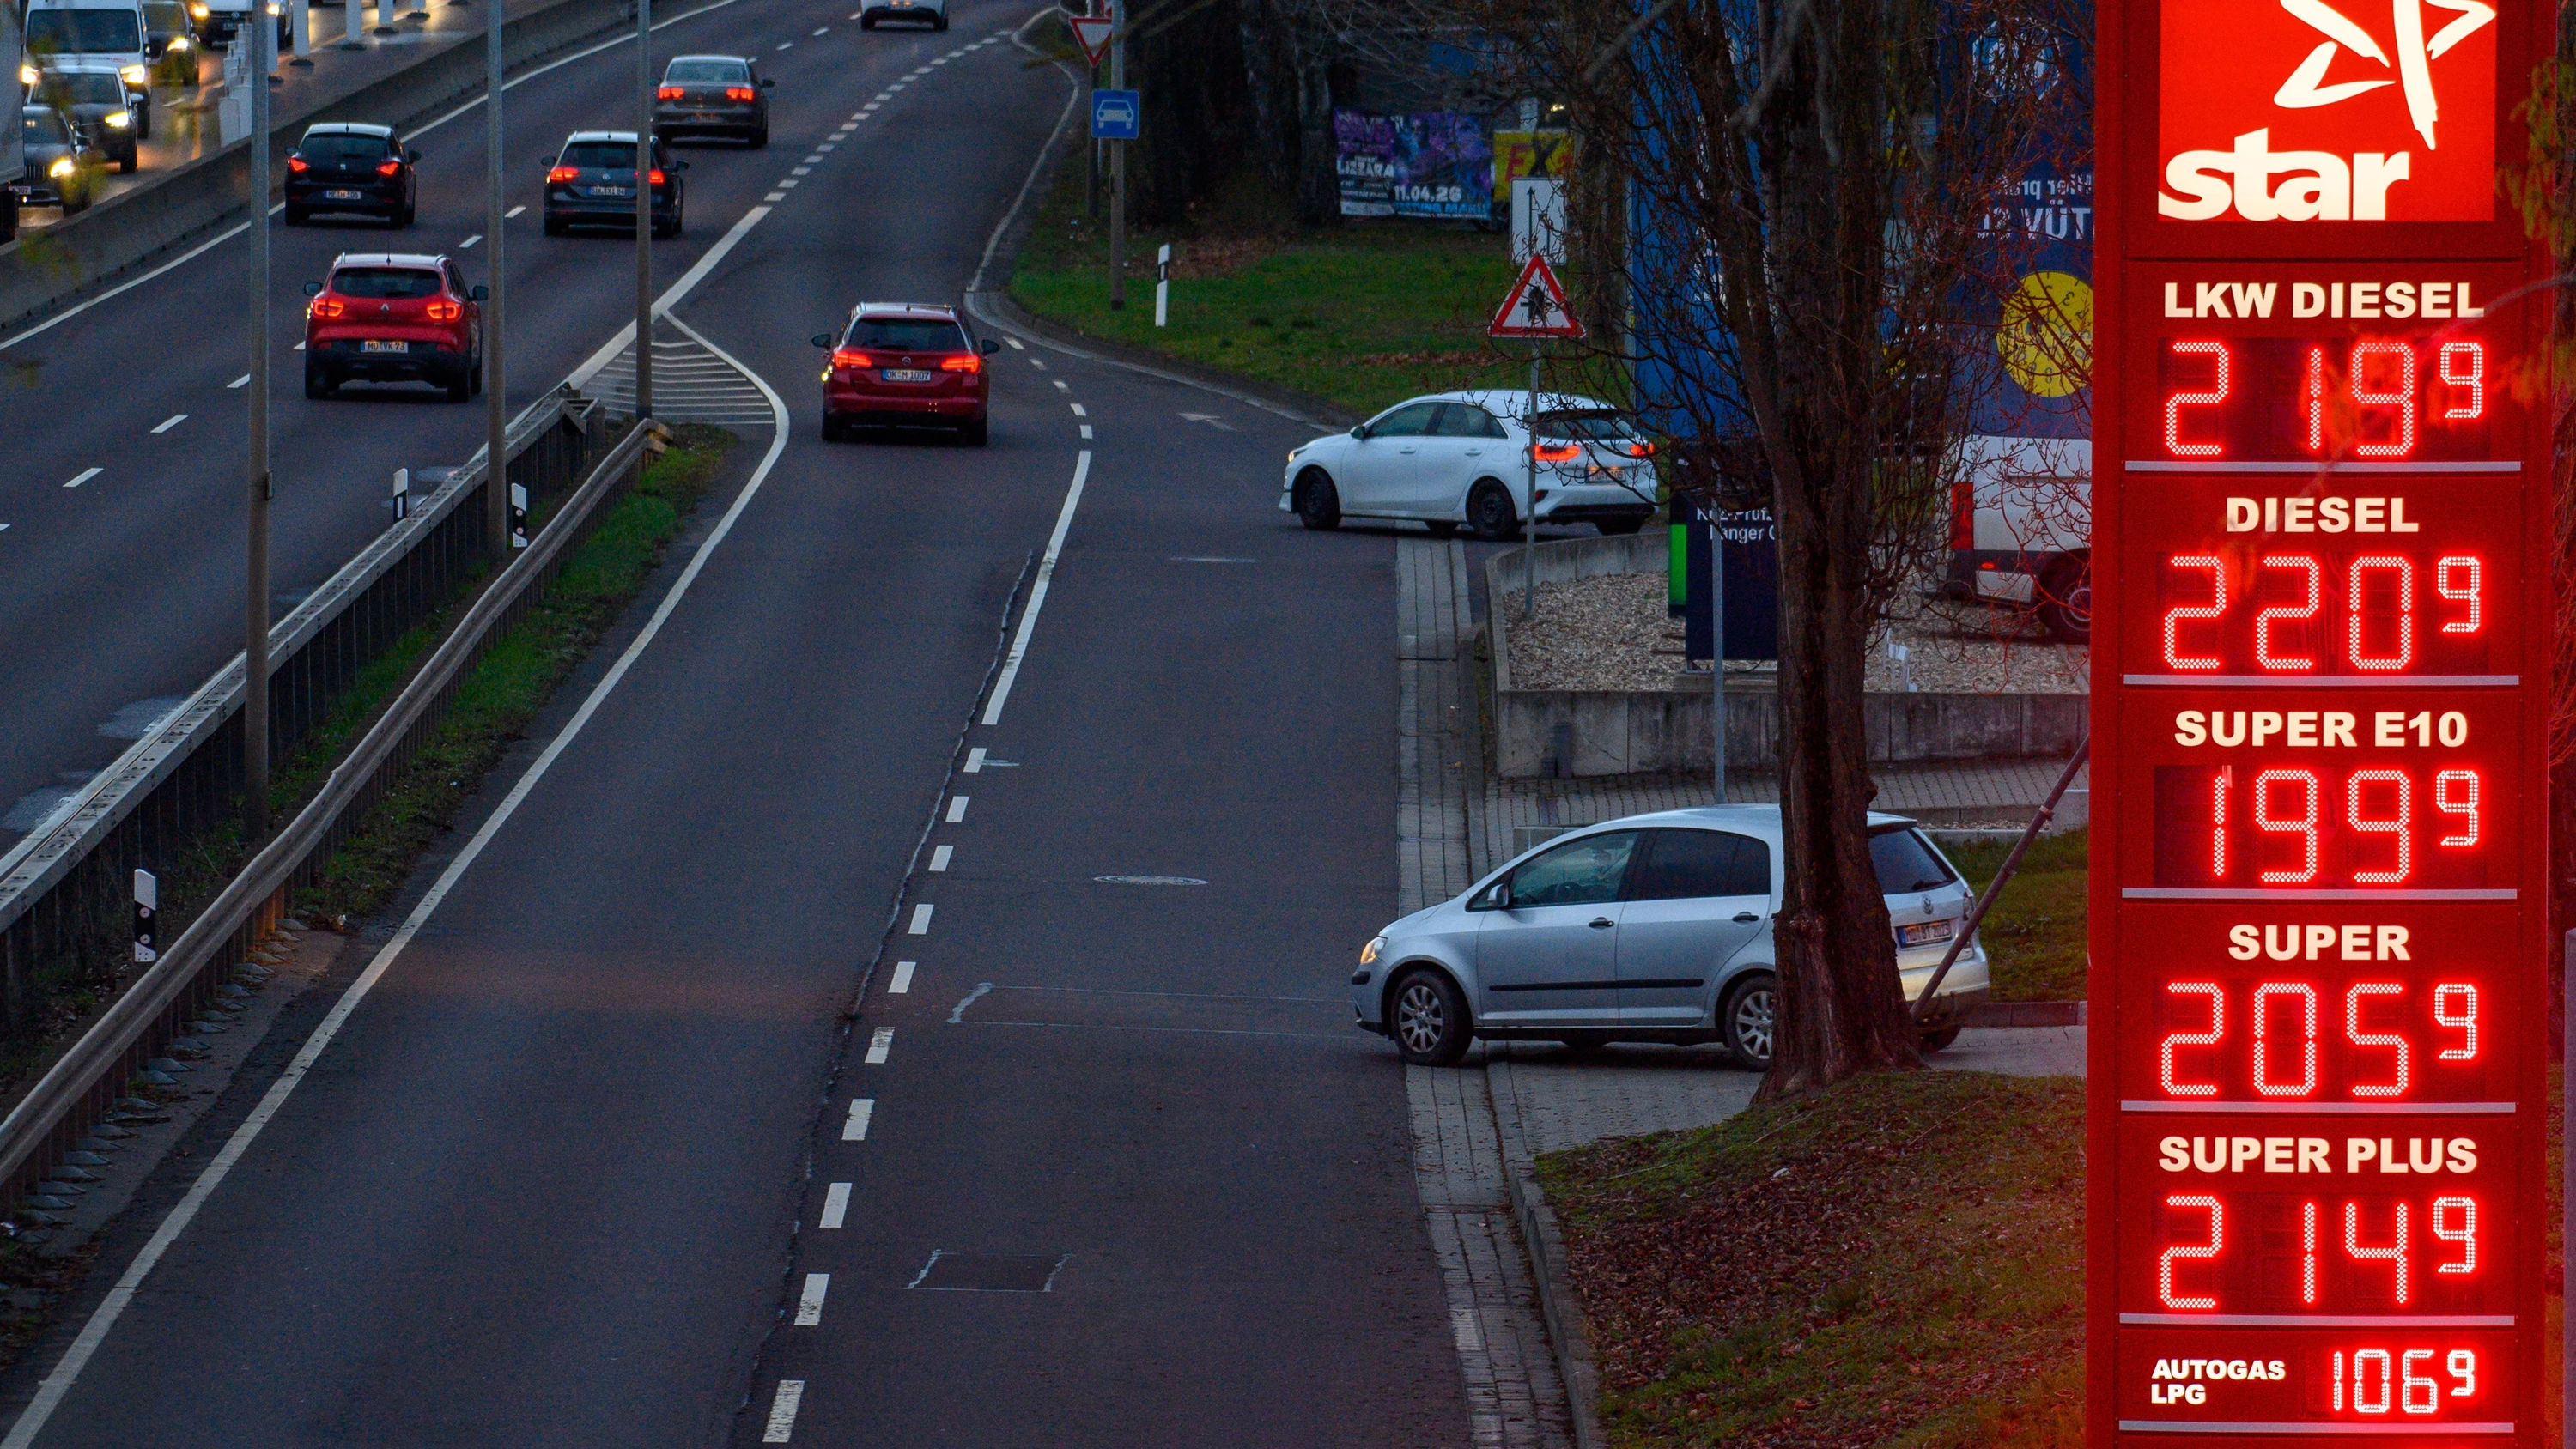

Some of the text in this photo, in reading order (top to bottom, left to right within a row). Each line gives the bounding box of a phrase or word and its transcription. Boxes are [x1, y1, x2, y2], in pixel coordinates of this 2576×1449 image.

[2158, 128, 2409, 221] star
[2165, 282, 2484, 318] LKW DIESEL
[2227, 497, 2419, 533] DIESEL
[2174, 711, 2468, 748] SUPER E10
[2227, 925, 2411, 961] SUPER
[2158, 1137, 2477, 1174] SUPER PLUS
[2151, 1359, 2286, 1381] AUTOGAS
[2151, 1383, 2207, 1405] LPG
